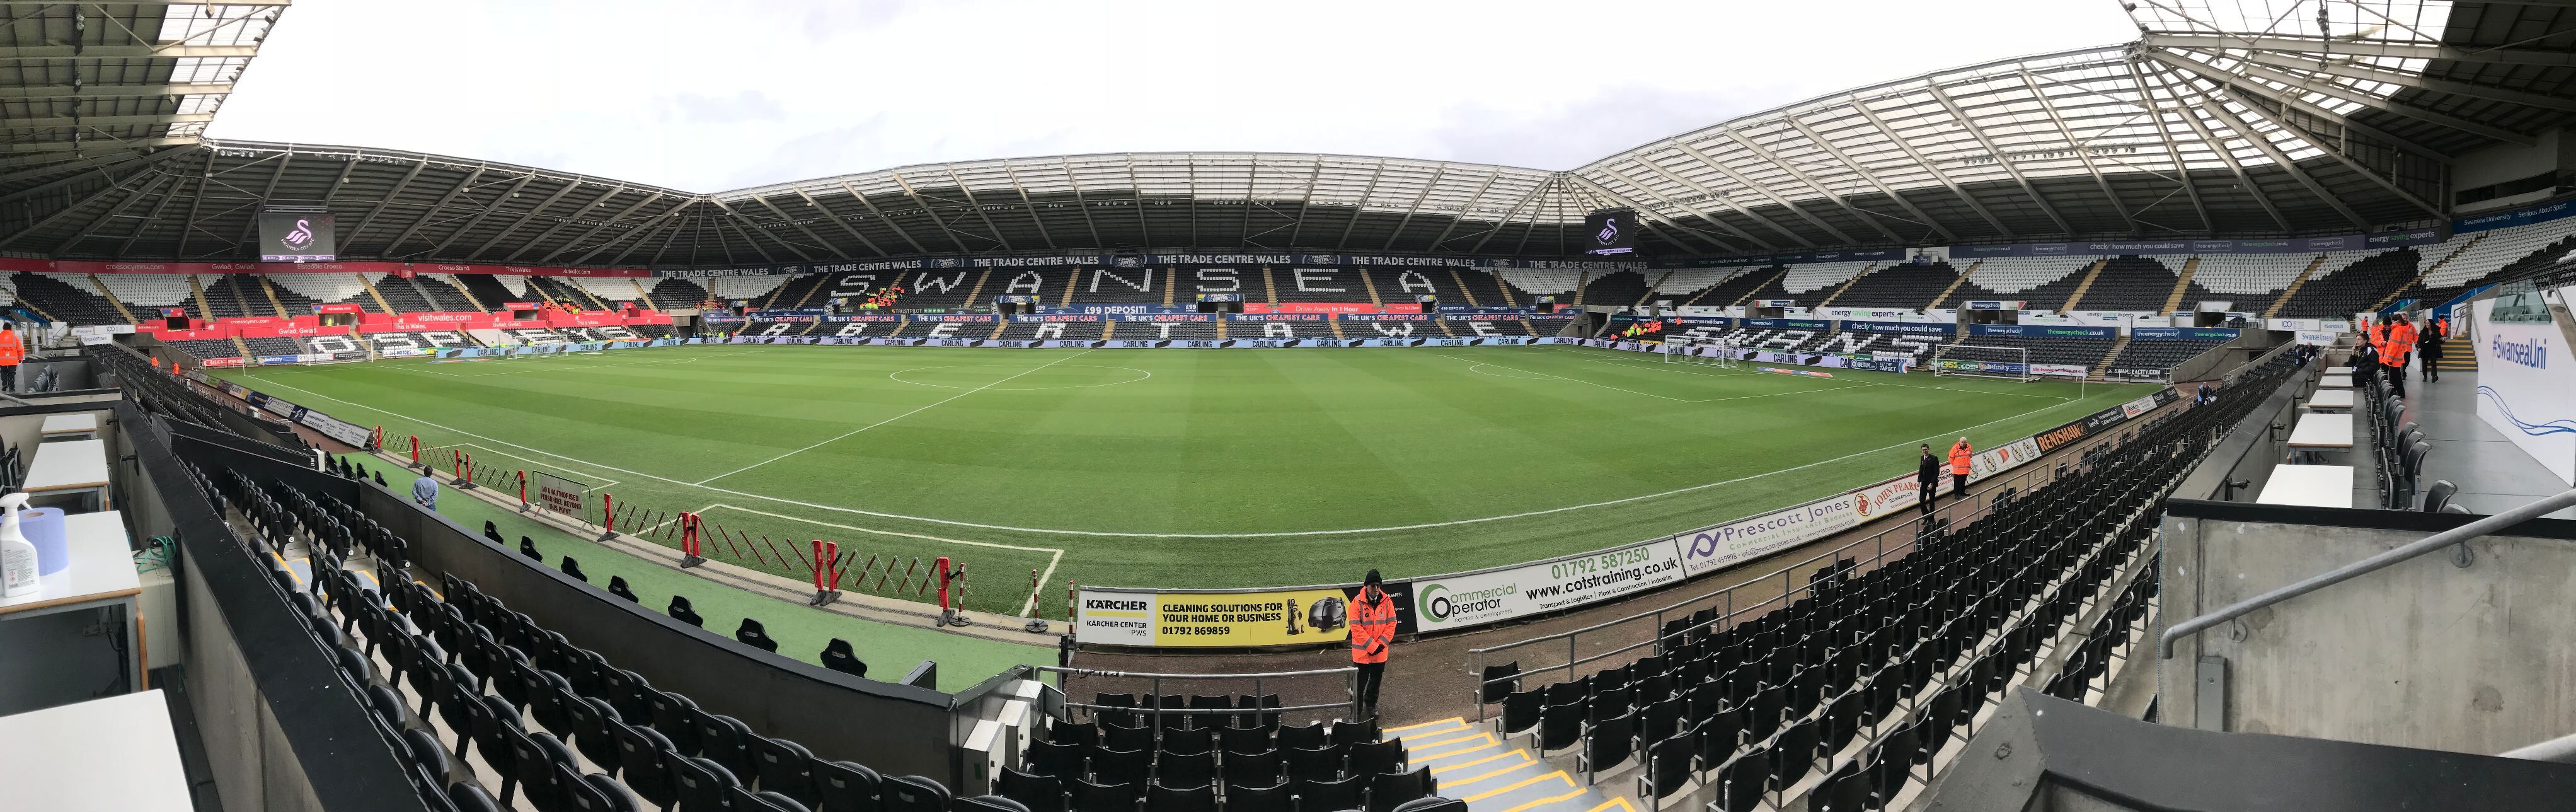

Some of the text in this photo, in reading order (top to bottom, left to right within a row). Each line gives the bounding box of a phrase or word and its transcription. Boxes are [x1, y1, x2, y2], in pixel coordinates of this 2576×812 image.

[2553, 202, 2566, 212] Sport
[2486, 214, 2511, 222] University
[974, 258, 991, 267] THE
[1026, 257, 1063, 265] CENTRE
[1065, 257, 1099, 265] WALES
[1158, 255, 1291, 264] THE TRADE CENTRE WALES
[1529, 260, 1648, 269] THE TRADE CENTRE WALES
[106, 264, 164, 272] croesocymru.com
[1851, 310, 1871, 318] saving
[478, 348, 498, 357] CARLING
[2492, 334, 2546, 370] #SwanseaUni
[2037, 422, 2081, 451] RENISHAW
[548, 487, 579, 502] UNAUTHORISED
[1874, 486, 1893, 509] JOHN
[1893, 482, 1920, 493] PEARC
[541, 494, 582, 510] PERSONNEL BEYOND
[549, 503, 572, 515] THIS POINT
[1723, 501, 1850, 541] Prescott Jones
[1699, 559, 1717, 569] 01792
[1718, 553, 1737, 564] 459898
[1742, 535, 1802, 558] info@prescott-jones.co.uk
[1805, 518, 1856, 538] www.prescott-jones.co.uk
[1551, 547, 1650, 580] 01792 587250
[1526, 557, 1678, 600] www.cotstraining.co.uk
[1539, 600, 1566, 610] Transport
[1571, 593, 1593, 604] Logistics
[1599, 589, 1611, 597] Plant
[1617, 581, 1647, 593] Construction
[1652, 575, 1672, 584] Industrial
[1086, 599, 1147, 611] KÄRCHER
[1163, 603, 1283, 612] CLEANING SOLUTIONS FOR
[1432, 596, 1502, 619] Operator
[1162, 612, 1282, 622] YOUR HOME OR BUSINESS
[1453, 614, 1474, 623] learning
[1480, 608, 1512, 619] development
[1086, 619, 1118, 627] KÄRCHER
[1162, 626, 1230, 635] 01792 869859
